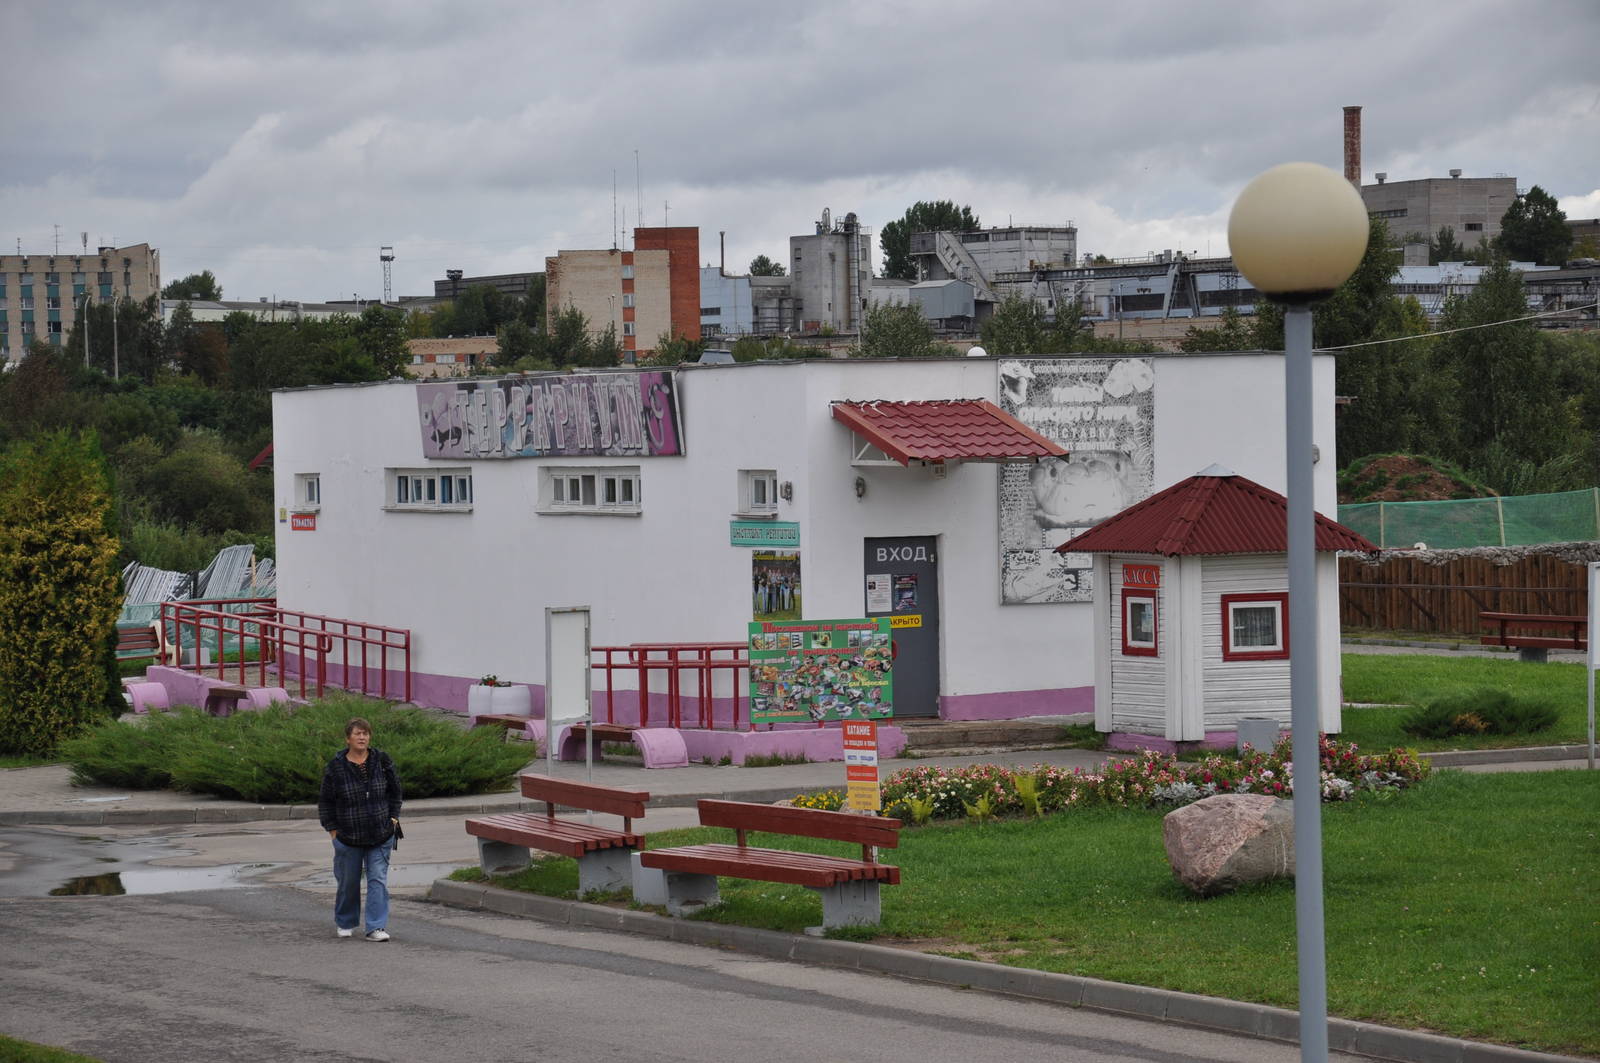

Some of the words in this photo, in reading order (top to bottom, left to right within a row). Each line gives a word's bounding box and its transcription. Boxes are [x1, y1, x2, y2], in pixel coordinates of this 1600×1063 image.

[455, 382, 643, 453] ТЕРРАРИУМ
[1039, 427, 1117, 439] ВЫСТАВКА
[876, 546, 928, 562] ВХОД
[1123, 567, 1160, 585] КАССА
[891, 616, 920, 626] КРЫТО
[846, 724, 871, 736] КАТАНИЕ
